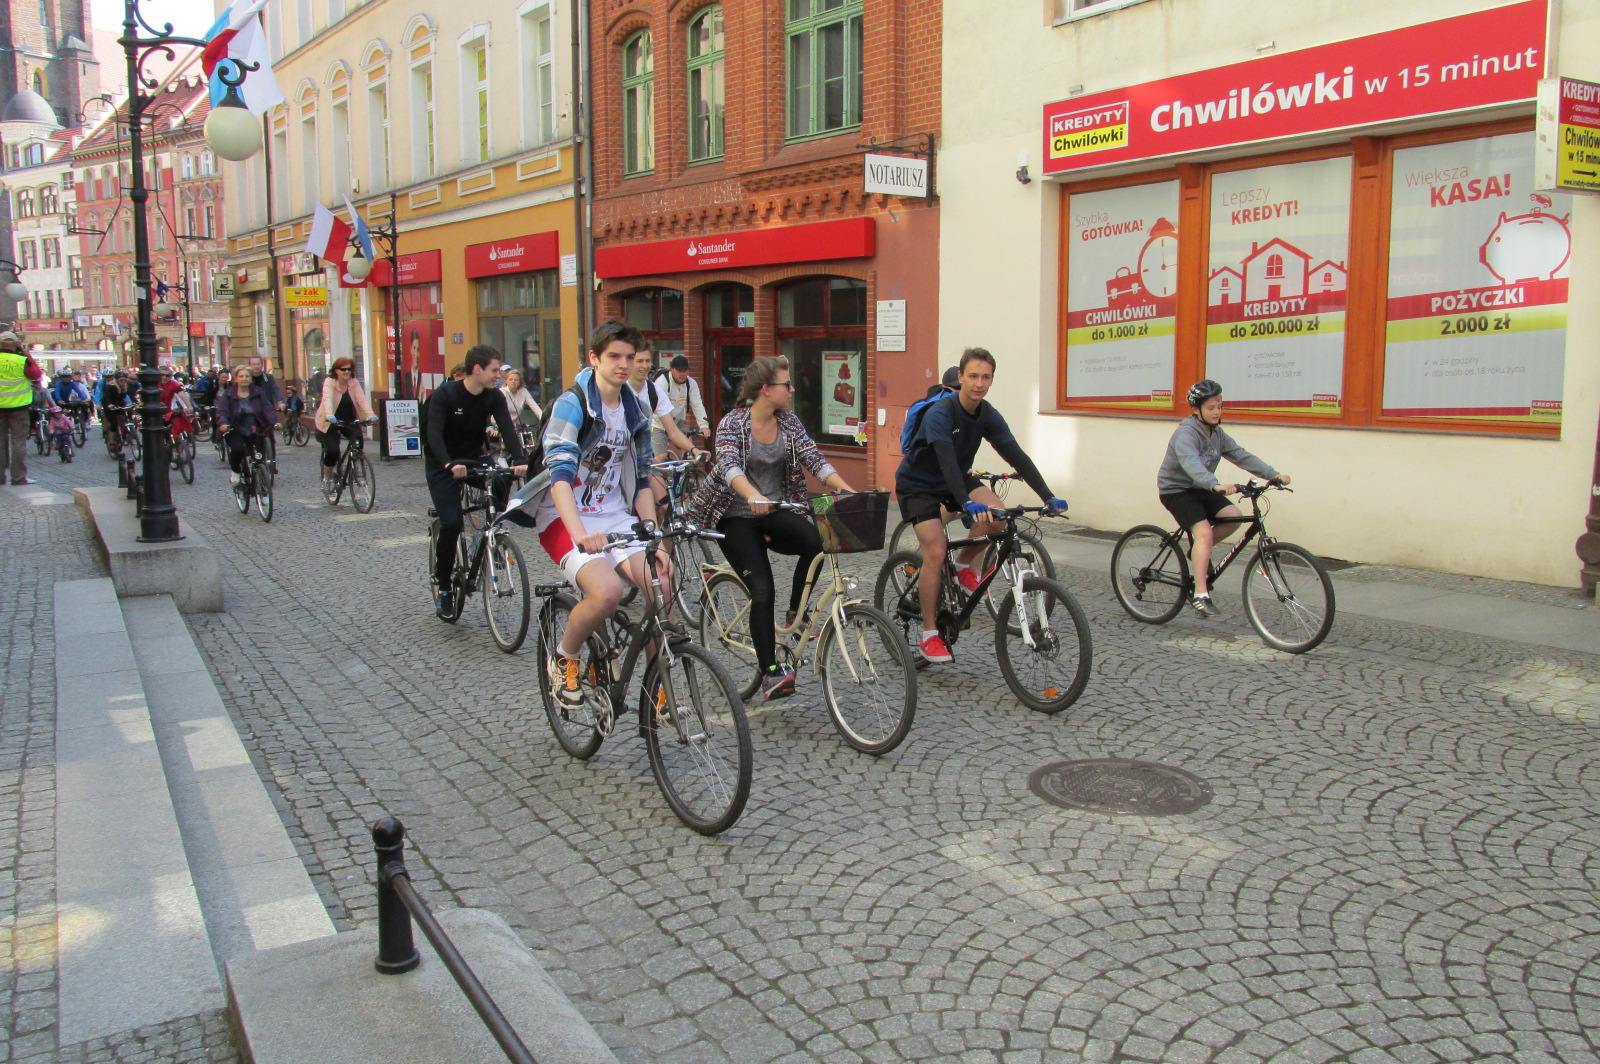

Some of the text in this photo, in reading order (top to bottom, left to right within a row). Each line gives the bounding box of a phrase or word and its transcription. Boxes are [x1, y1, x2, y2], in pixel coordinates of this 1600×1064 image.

[1150, 47, 1538, 132] Chwilówki w 15 minut
[1054, 108, 1124, 132] KREDYTY
[1053, 127, 1124, 152] Chwilówki
[1576, 150, 1584, 162] 15
[870, 163, 924, 188] NOTARIUSZ
[1405, 166, 1469, 188] Większa
[1222, 183, 1271, 208] Lepszy
[1430, 173, 1512, 208] KASA!
[1075, 211, 1109, 228] Szybka
[1231, 200, 1299, 226] KREDYT!
[1081, 219, 1144, 242] GOTÓWKA!
[698, 238, 736, 255] Santander
[1243, 297, 1308, 317] KREDYTY
[1431, 287, 1524, 312] POŻYCZKI
[1085, 303, 1157, 326] CHWILÓWKI
[1440, 313, 1511, 335] 2.000 zł
[1091, 323, 1149, 341] do 1.000 zł
[1230, 316, 1320, 338] do 200.000 zł
